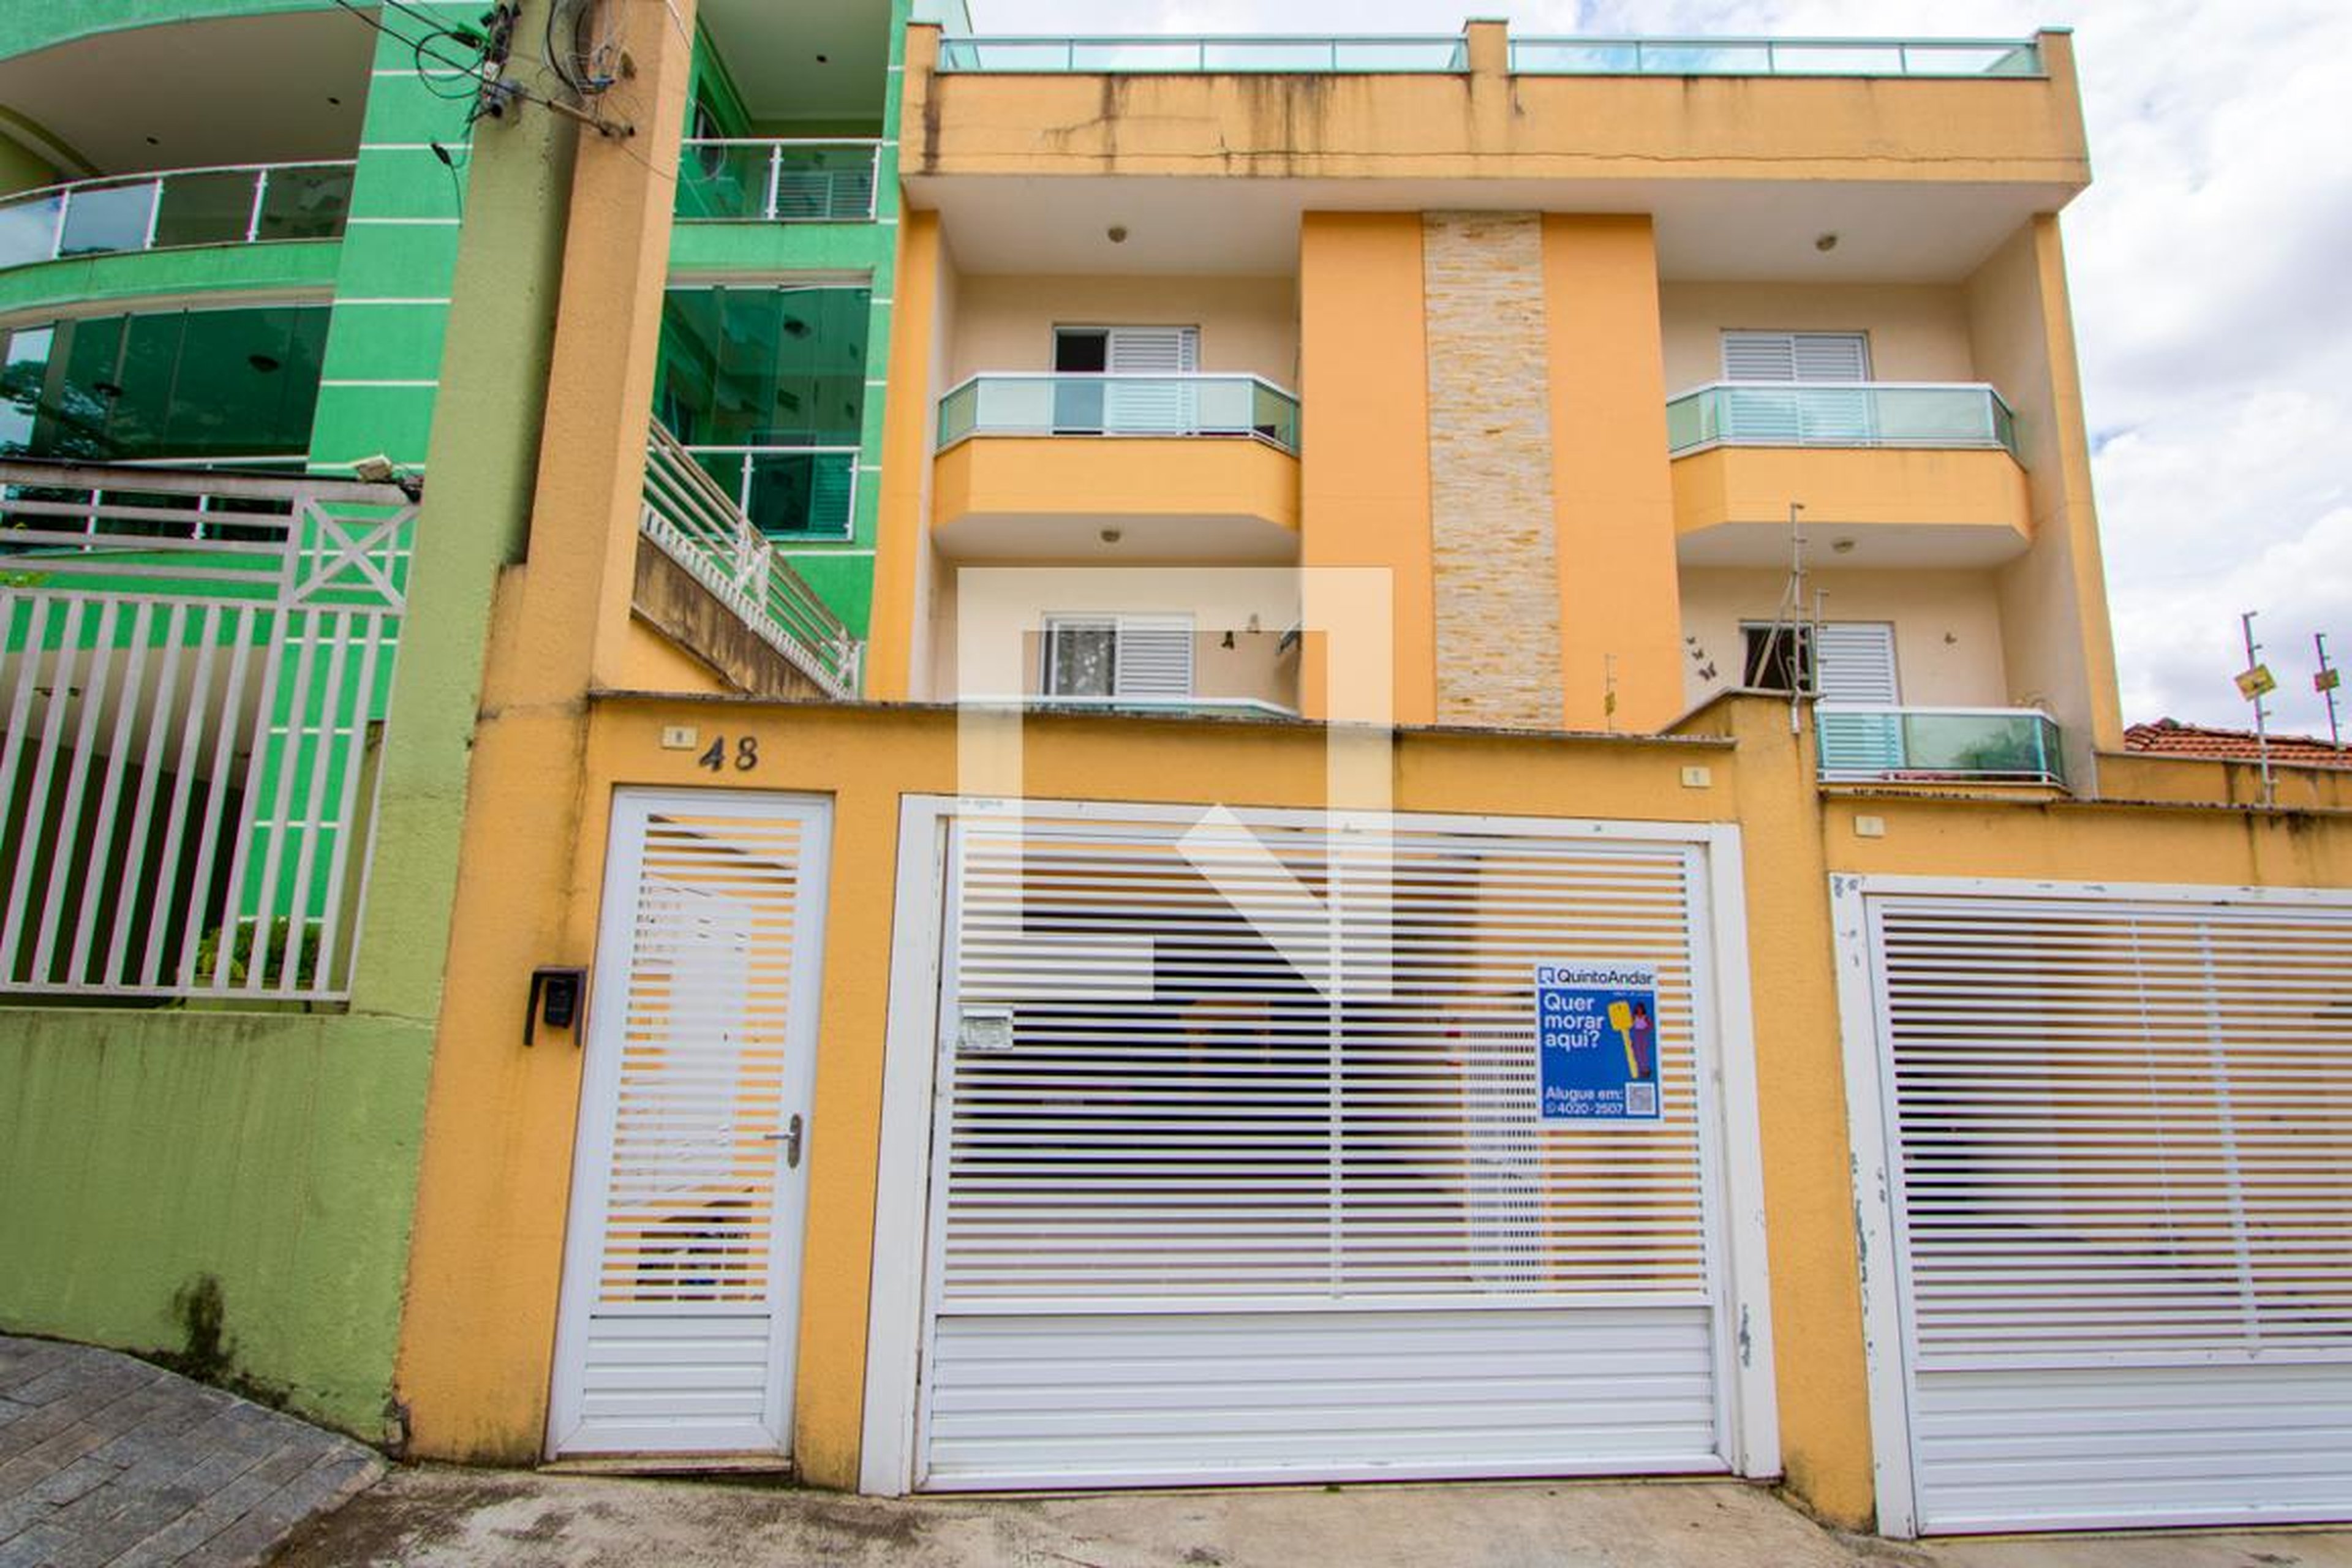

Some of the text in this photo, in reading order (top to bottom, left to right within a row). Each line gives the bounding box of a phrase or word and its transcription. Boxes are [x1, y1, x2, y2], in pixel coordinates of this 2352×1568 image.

[699, 736, 758, 771] 48
[1557, 968, 1653, 984] QuintoAndar
[1544, 993, 1595, 1011] Quer
[1544, 1014, 1604, 1030] morar
[1545, 1030, 1600, 1052] aqui?
[1545, 1086, 1623, 1102] Alugue em:
